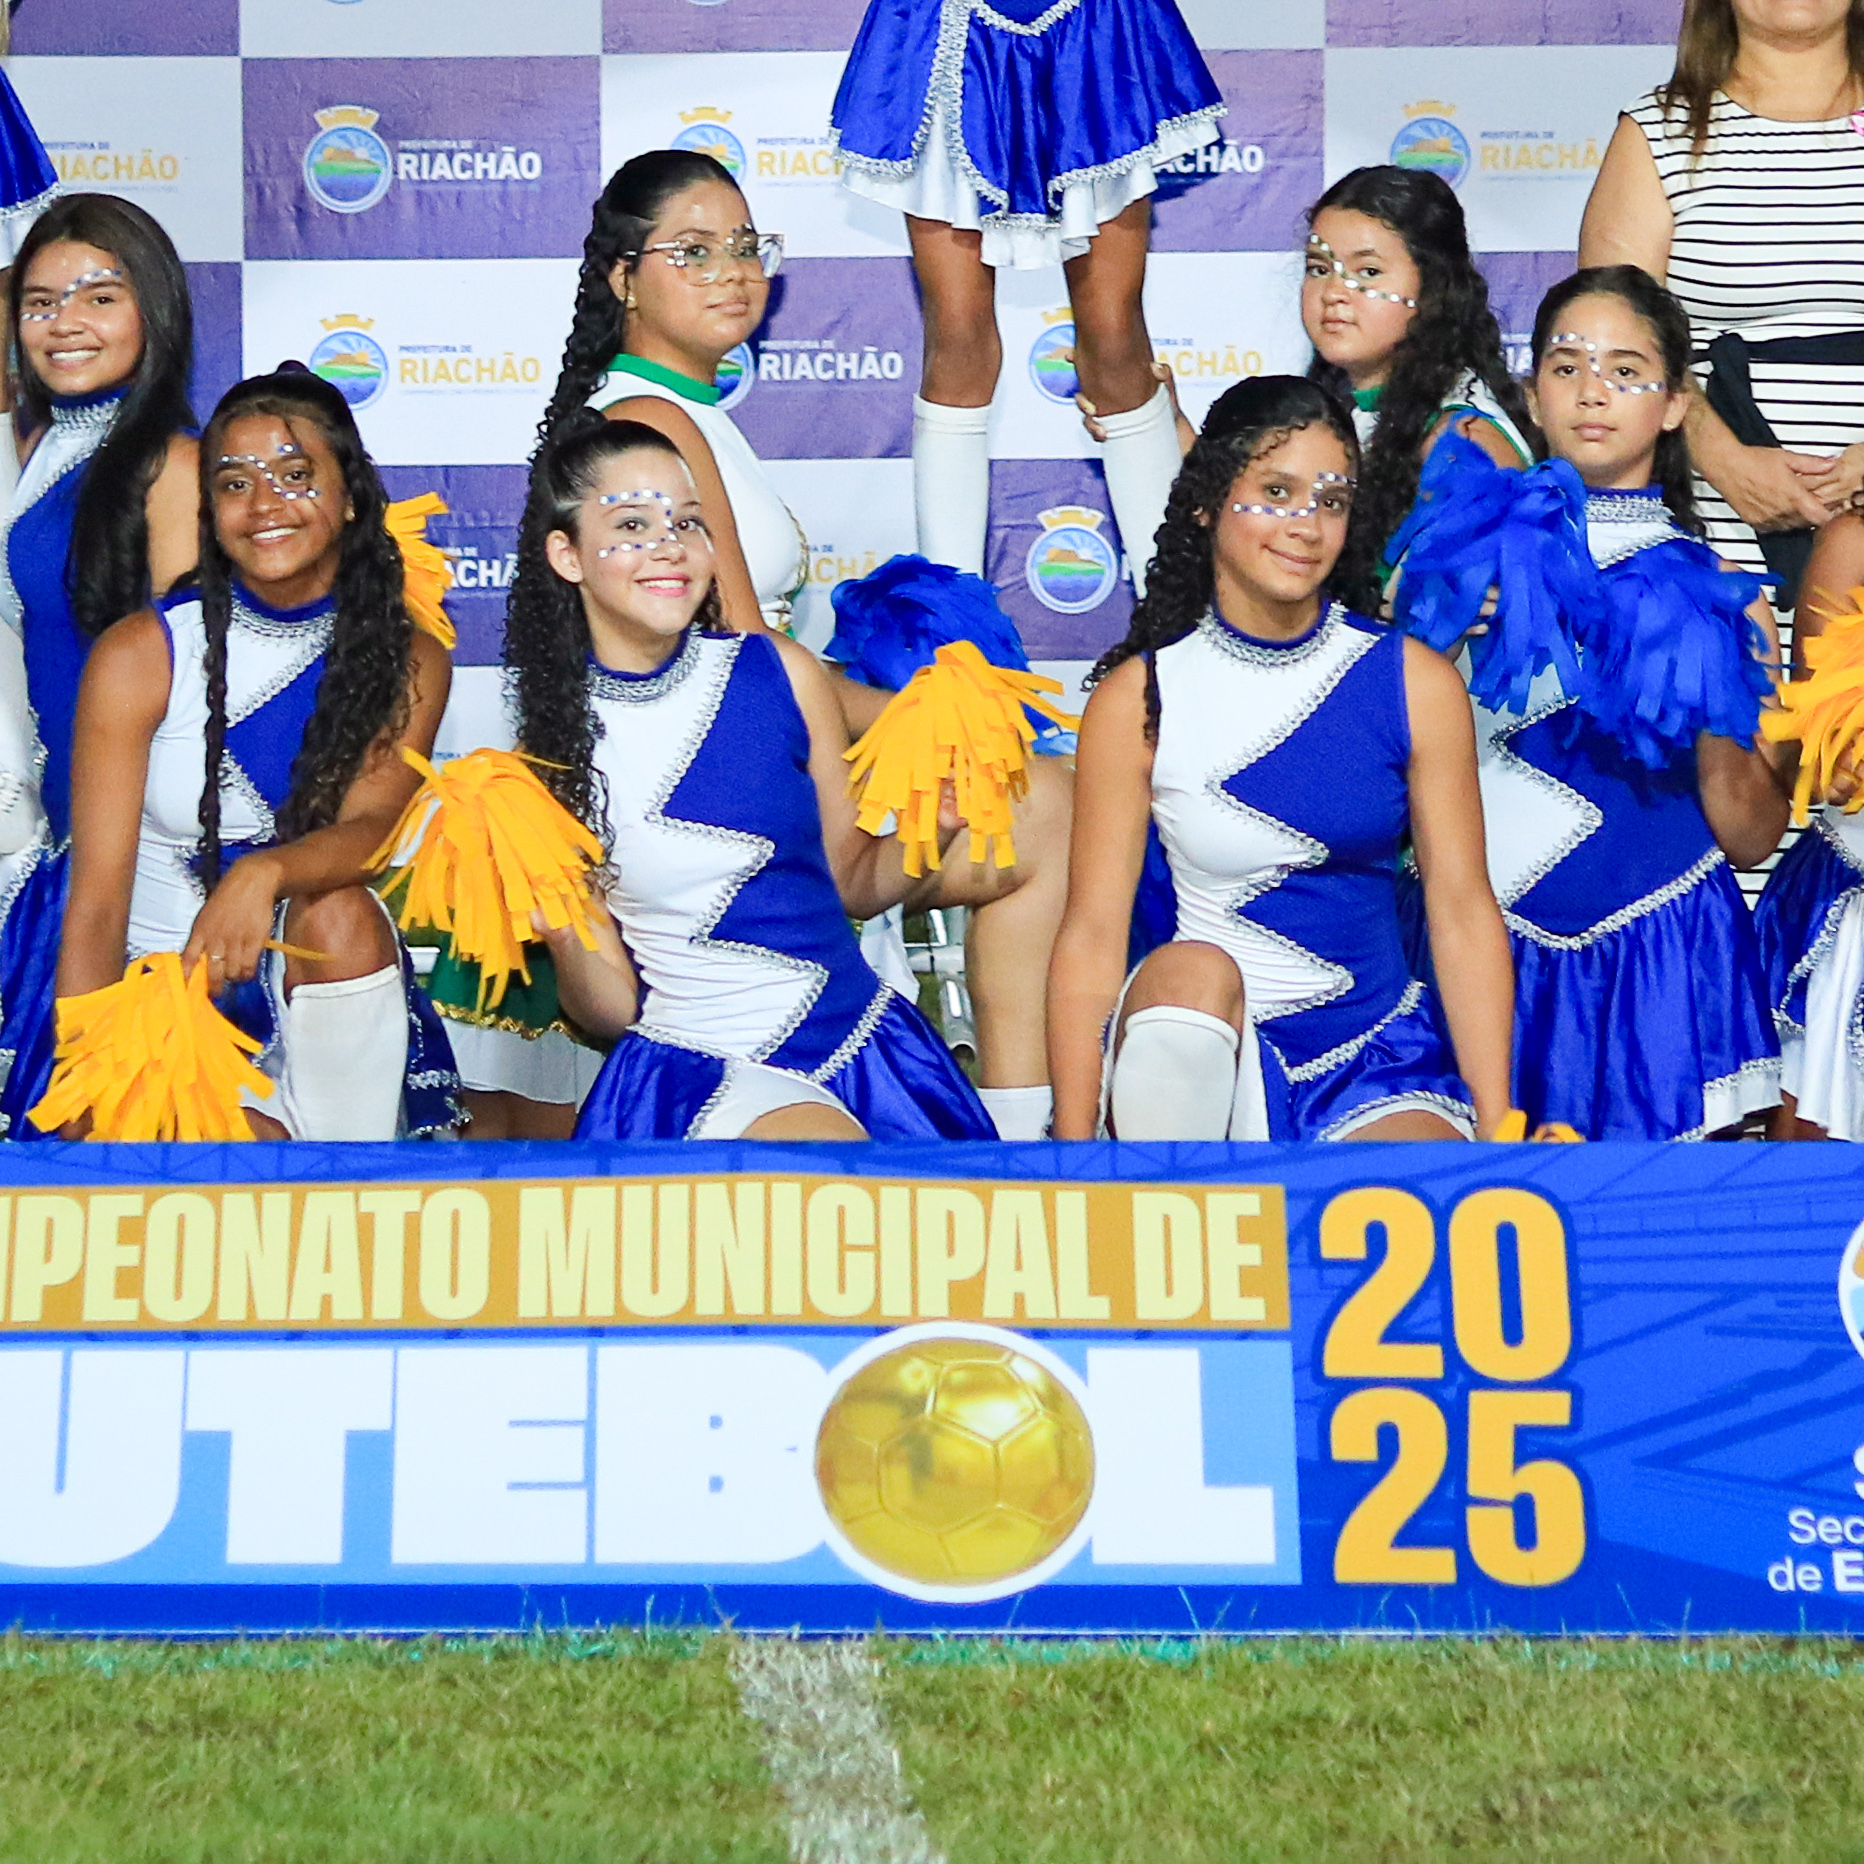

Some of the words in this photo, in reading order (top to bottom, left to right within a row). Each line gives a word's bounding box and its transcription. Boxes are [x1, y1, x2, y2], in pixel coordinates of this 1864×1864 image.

[398, 146, 542, 180] RIACHÃO
[1480, 138, 1602, 170] RIACHÃ
[399, 352, 541, 384] RIACHÃO
[759, 346, 904, 381] RIACHÃO
[517, 1182, 1111, 1319] MUNICIPAL
[1132, 1191, 1266, 1321] DE
[1319, 1185, 1573, 1382] 20
[1329, 1385, 1586, 1586] 25
[1767, 1556, 1822, 1593] de
